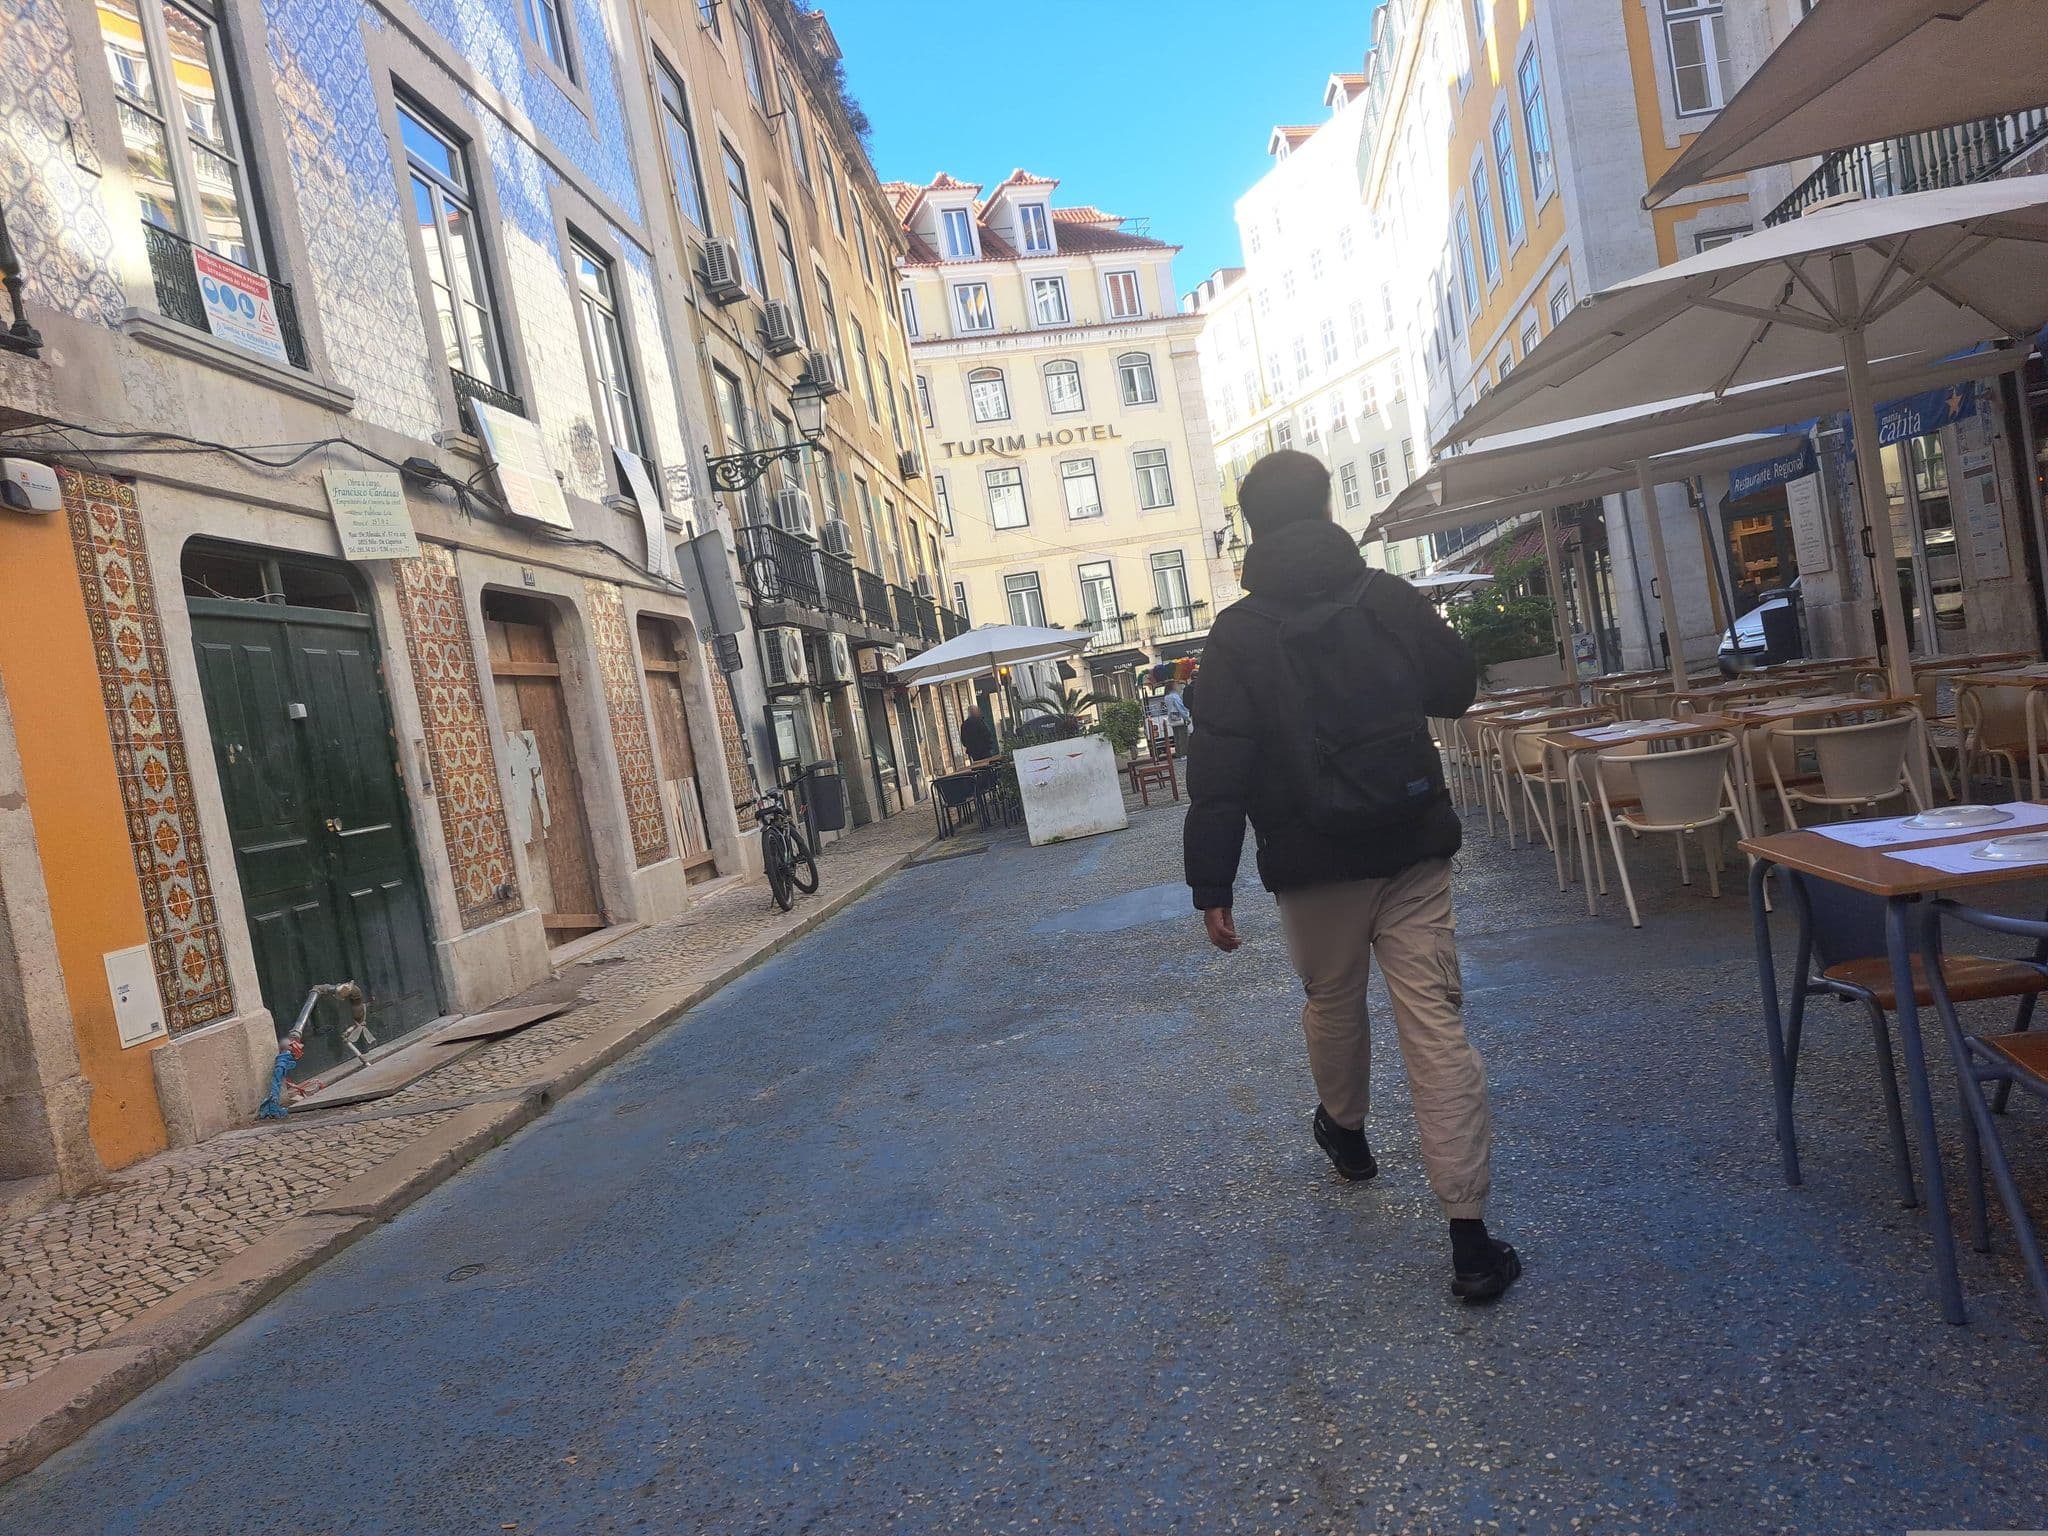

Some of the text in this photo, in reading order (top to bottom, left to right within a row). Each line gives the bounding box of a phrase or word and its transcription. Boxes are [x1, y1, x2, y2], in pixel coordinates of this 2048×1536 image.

[940, 424, 1122, 458] TURIM HOTEL
[1734, 454, 1804, 491] Restaurante Regional
[332, 487, 368, 497] Francisco
[1113, 662, 1133, 670] TURIM
